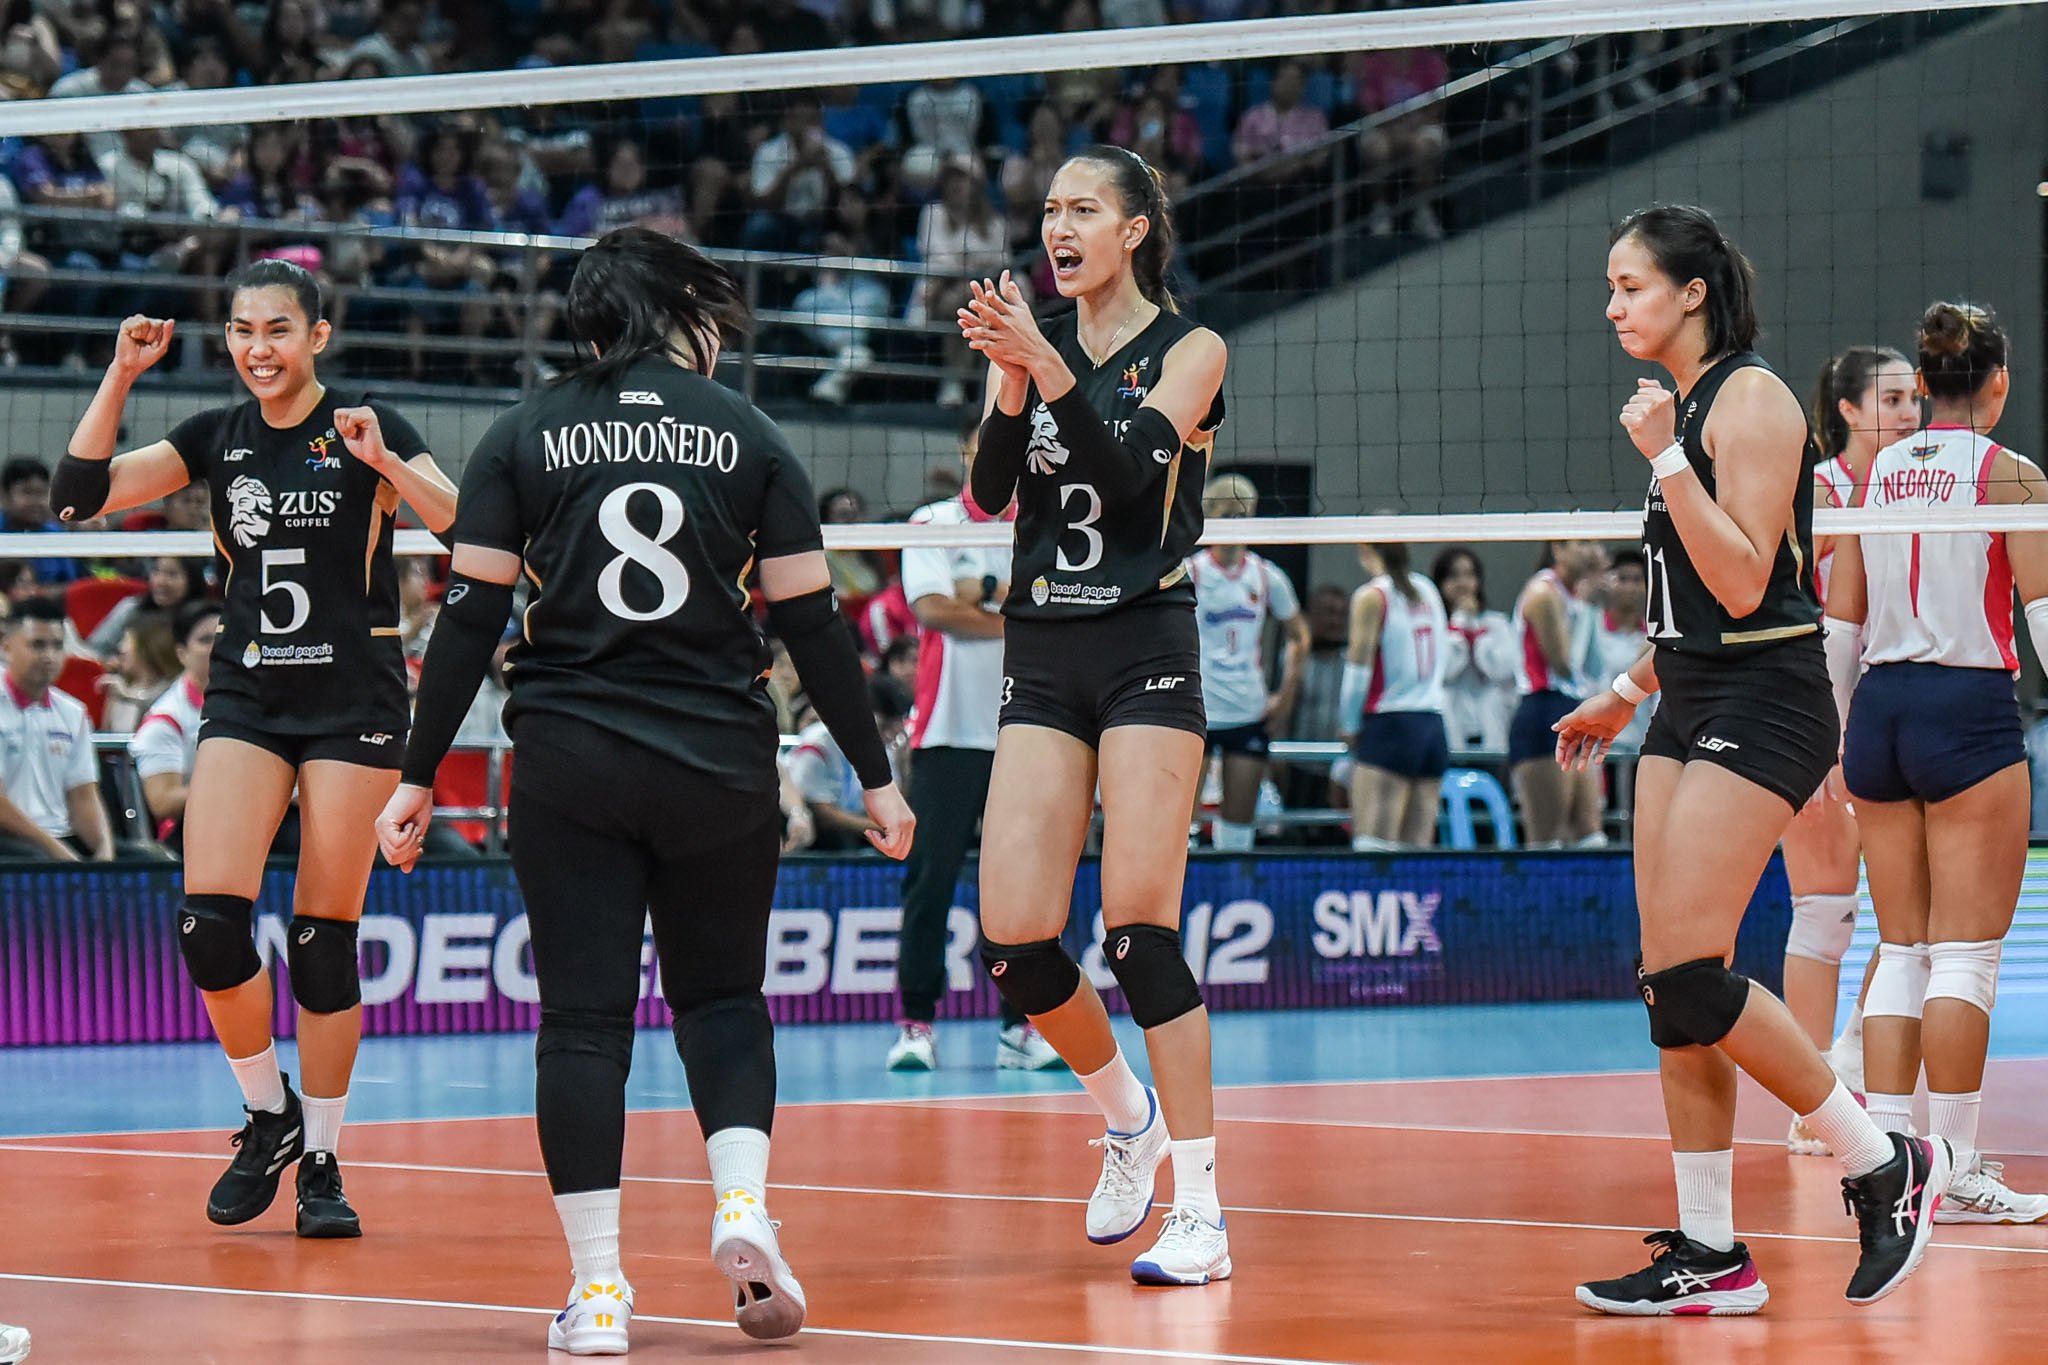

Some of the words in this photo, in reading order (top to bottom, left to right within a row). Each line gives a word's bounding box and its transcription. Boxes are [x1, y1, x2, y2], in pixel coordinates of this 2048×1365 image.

[325, 456, 342, 469] PVL
[542, 415, 739, 473] MONDOÑEDO
[1883, 468, 1956, 505] NEGRITO
[285, 518, 330, 528] COFFEE
[597, 482, 690, 621] 8
[1055, 483, 1104, 572] 3
[260, 548, 311, 635] 5
[1051, 582, 1081, 595] beard
[1081, 586, 1121, 599] papa's
[262, 645, 294, 657] beard
[295, 643, 333, 659] papa's
[1184, 899, 1275, 985] 12
[1312, 889, 1442, 959] SMX
